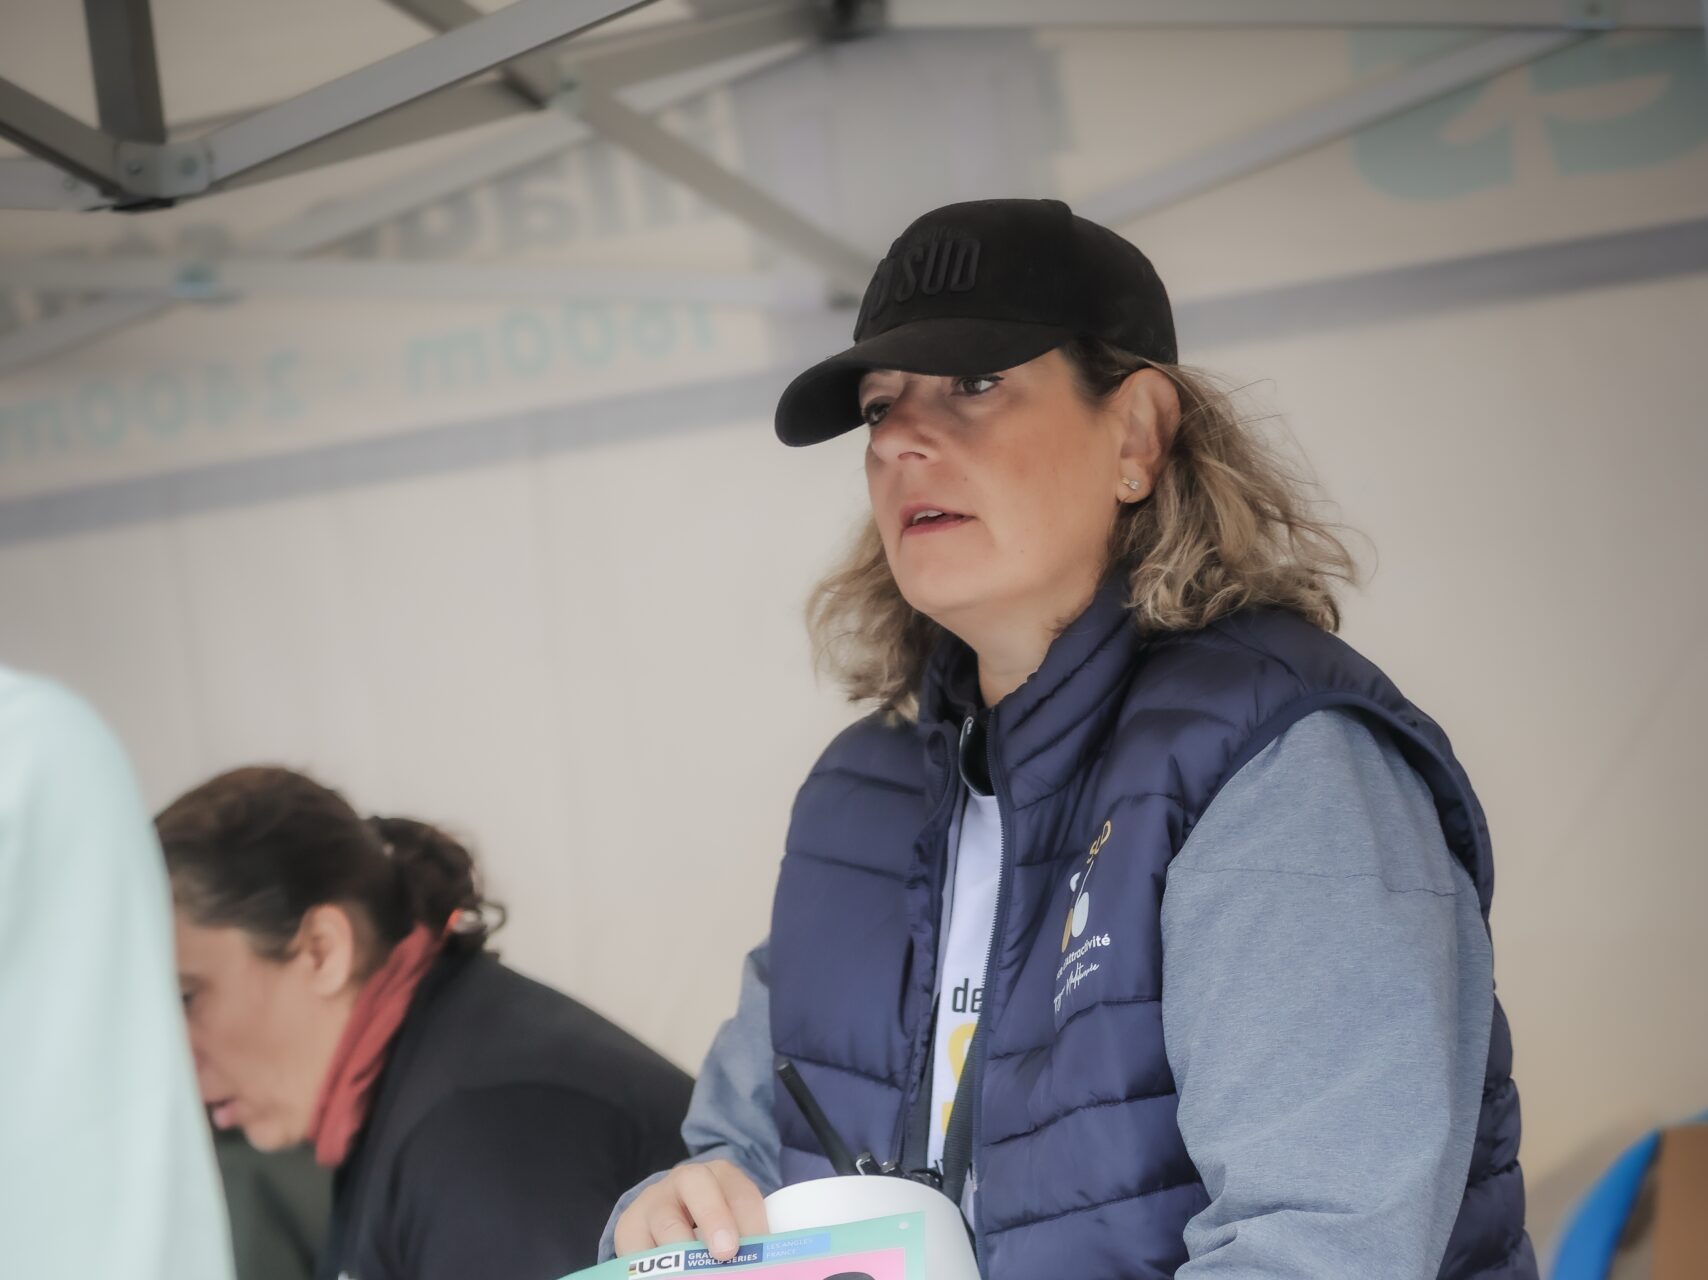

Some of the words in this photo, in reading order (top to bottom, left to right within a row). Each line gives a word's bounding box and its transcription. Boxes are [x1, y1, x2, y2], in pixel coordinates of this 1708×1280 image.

[952, 978, 983, 1013] de
[638, 1254, 680, 1274] UCI
[688, 1252, 714, 1260] GRAV
[688, 1258, 724, 1268] WORLD
[727, 1253, 758, 1265] SERIES
